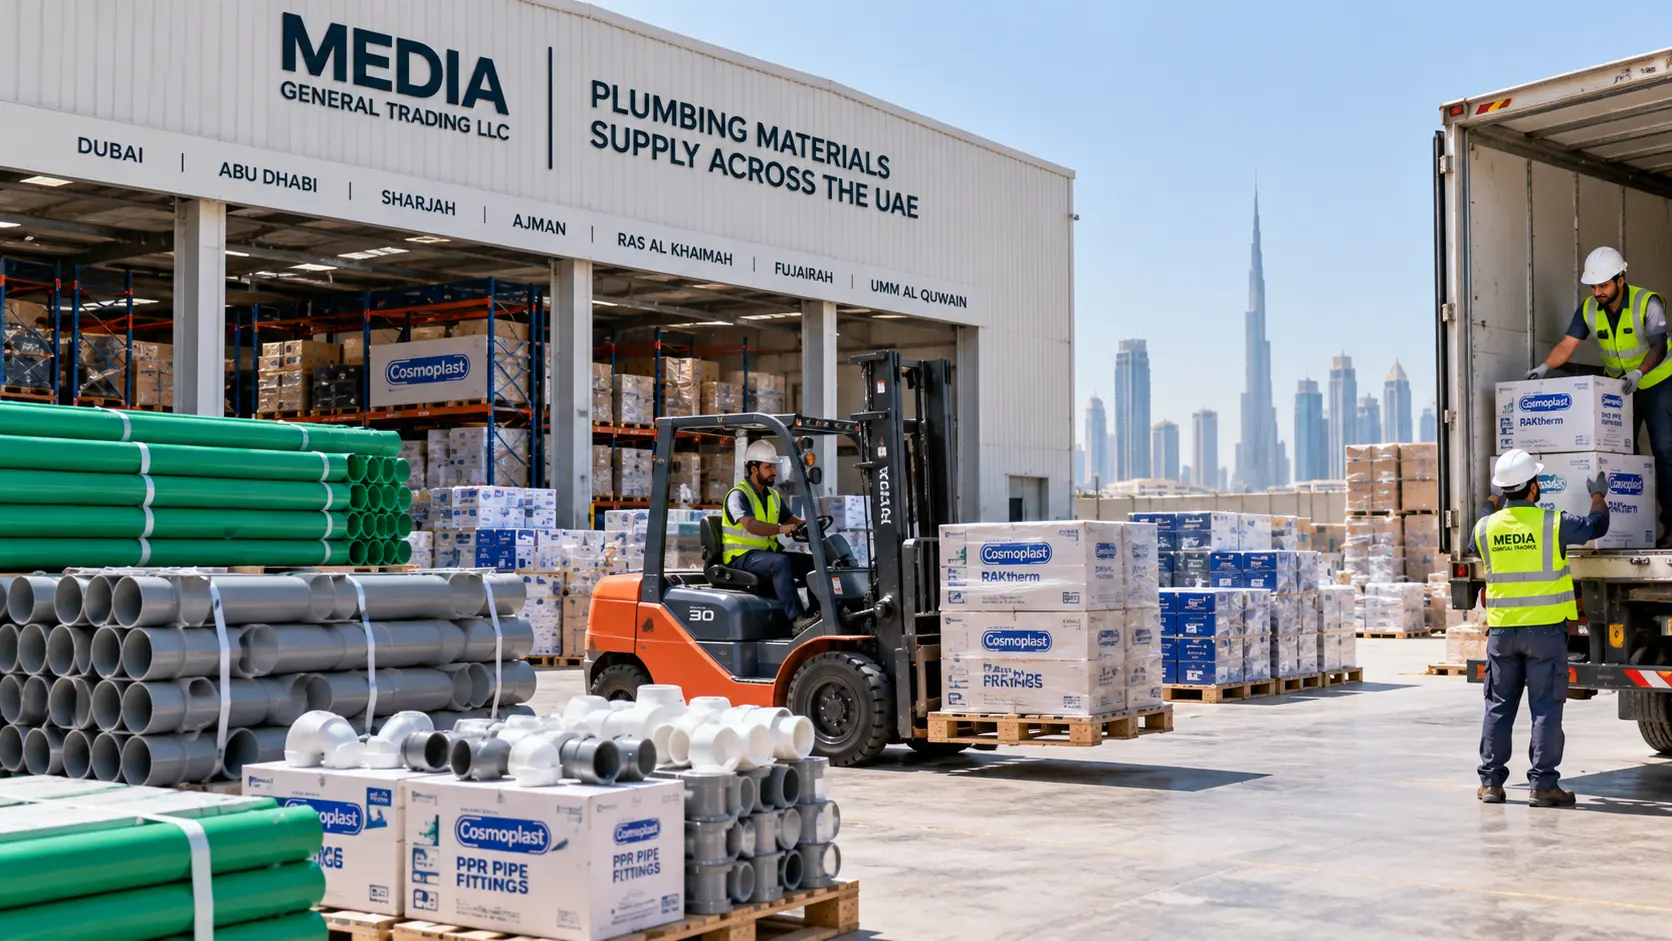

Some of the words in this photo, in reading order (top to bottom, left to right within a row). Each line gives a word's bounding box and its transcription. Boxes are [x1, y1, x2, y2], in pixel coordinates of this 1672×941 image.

[282, 12, 509, 116] MEDIA
[281, 81, 380, 118] GENERAL
[386, 101, 470, 134] TRADING
[477, 120, 509, 142] LLC
[591, 80, 748, 144] PLUMBING
[757, 121, 890, 180] MATERIALS
[77, 136, 143, 164] DUBAI
[219, 162, 257, 183] ABU
[263, 169, 318, 193] DHABI
[590, 120, 701, 168] SUPPLY
[708, 147, 817, 196] ACROSS
[823, 174, 869, 208] THE
[876, 186, 919, 220] UAE
[381, 189, 456, 217] SHARJAH
[513, 213, 567, 236] AJMAN
[618, 232, 646, 251] RAS
[649, 239, 668, 255] AL
[671, 242, 733, 267] KHAIMAH
[775, 262, 834, 284] FUJAIRAH
[871, 278, 900, 297] UMM
[903, 285, 918, 300] AL
[920, 288, 968, 309] QUWAIN
[390, 360, 465, 379] Cosmoplast
[1519, 416, 1564, 427] RAKtherm
[1494, 532, 1535, 546] MEDIA
[983, 545, 1048, 562] Cosmoplast
[981, 571, 1040, 583] RAKtherm
[689, 610, 715, 622] 30
[985, 633, 1048, 650] Cosmoplast
[319, 807, 359, 829] oplast
[459, 821, 545, 848] Cosmoplast
[456, 856, 488, 875] PPR
[492, 859, 529, 880] PIPE
[613, 851, 635, 868] PPR
[636, 847, 660, 863] PIPE
[456, 873, 530, 895] FITTINGS
[612, 861, 661, 884] FITTINGS
